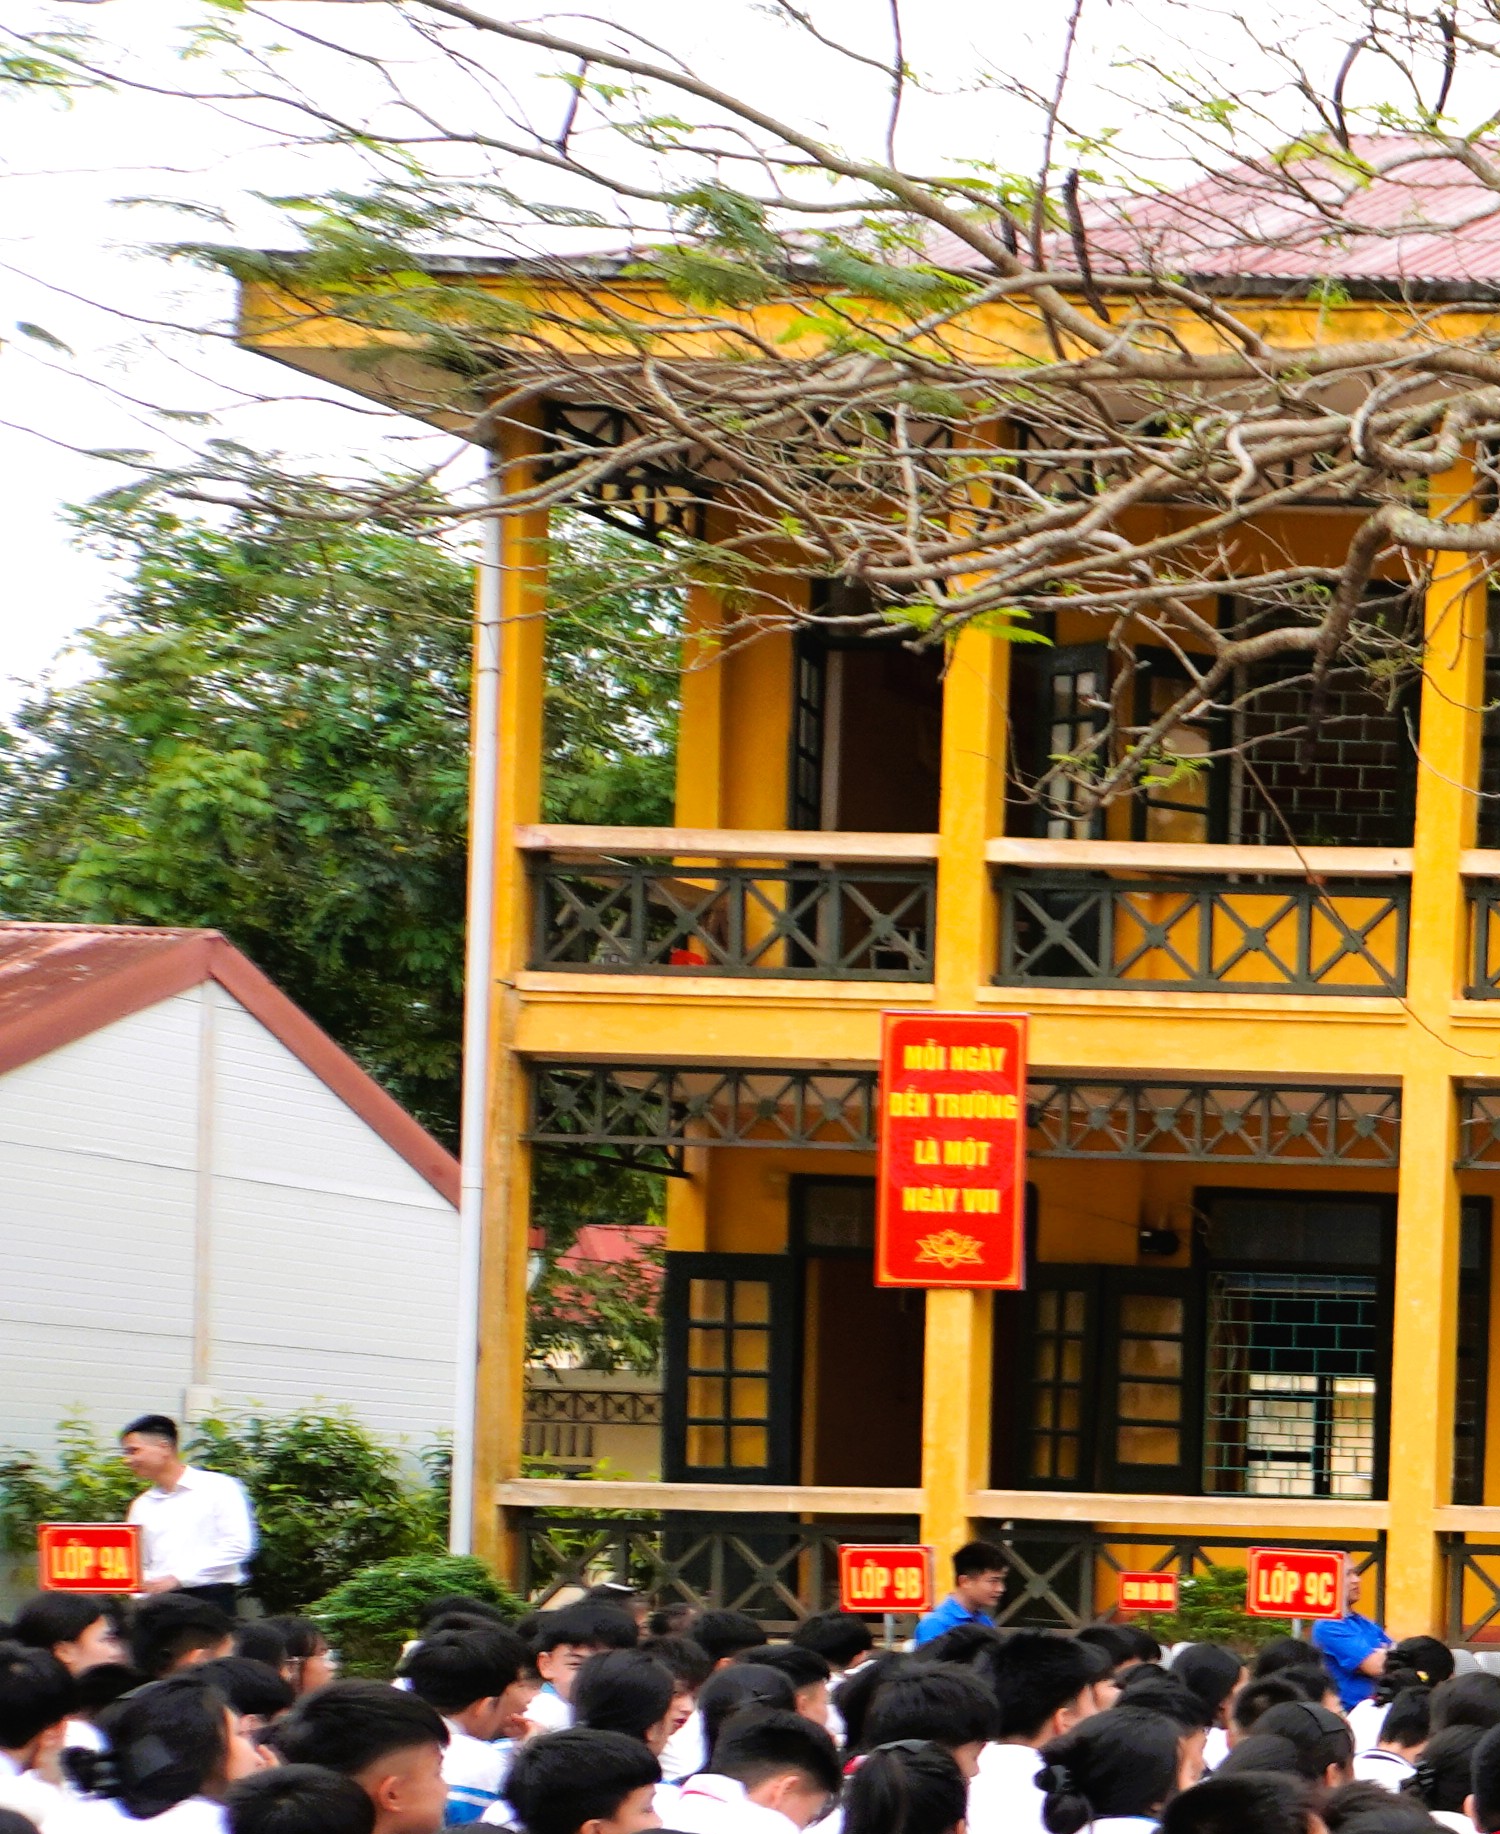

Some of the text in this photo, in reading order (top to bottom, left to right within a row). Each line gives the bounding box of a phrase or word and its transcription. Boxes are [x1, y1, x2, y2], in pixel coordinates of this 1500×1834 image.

[951, 1043, 1007, 1072] NGÀY
[914, 1137, 991, 1170] LÀ MỘT
[902, 1184, 1000, 1213] NGÀY VUI
[51, 1537, 127, 1580] LỚP 9A
[849, 1561, 922, 1601] LỚP 9B
[1257, 1562, 1333, 1605] LỚP 9C
